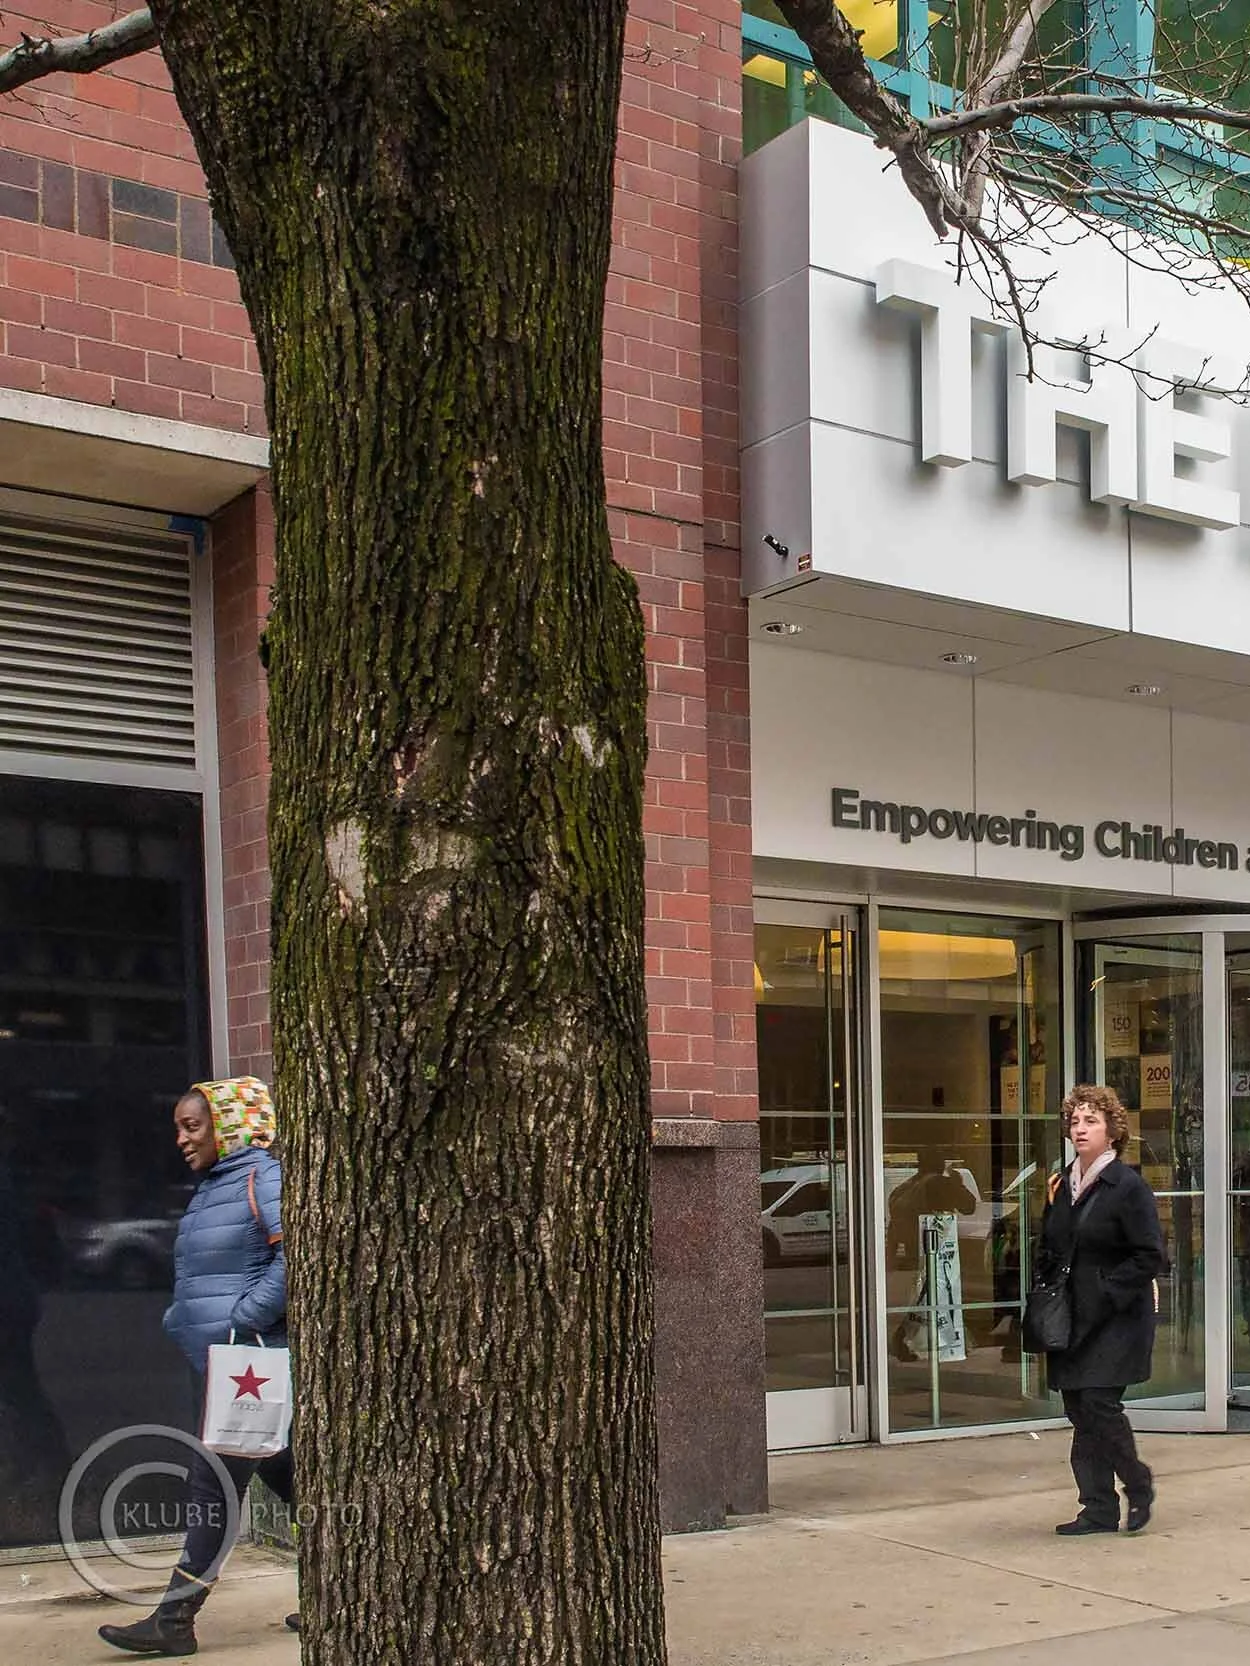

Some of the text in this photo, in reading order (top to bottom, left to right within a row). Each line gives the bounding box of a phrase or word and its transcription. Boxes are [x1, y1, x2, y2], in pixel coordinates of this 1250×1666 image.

[875, 258, 1240, 531] THE
[830, 787, 1084, 861] Empowering
[1095, 819, 1238, 870] Children
[1146, 1066, 1170, 1081] 200
